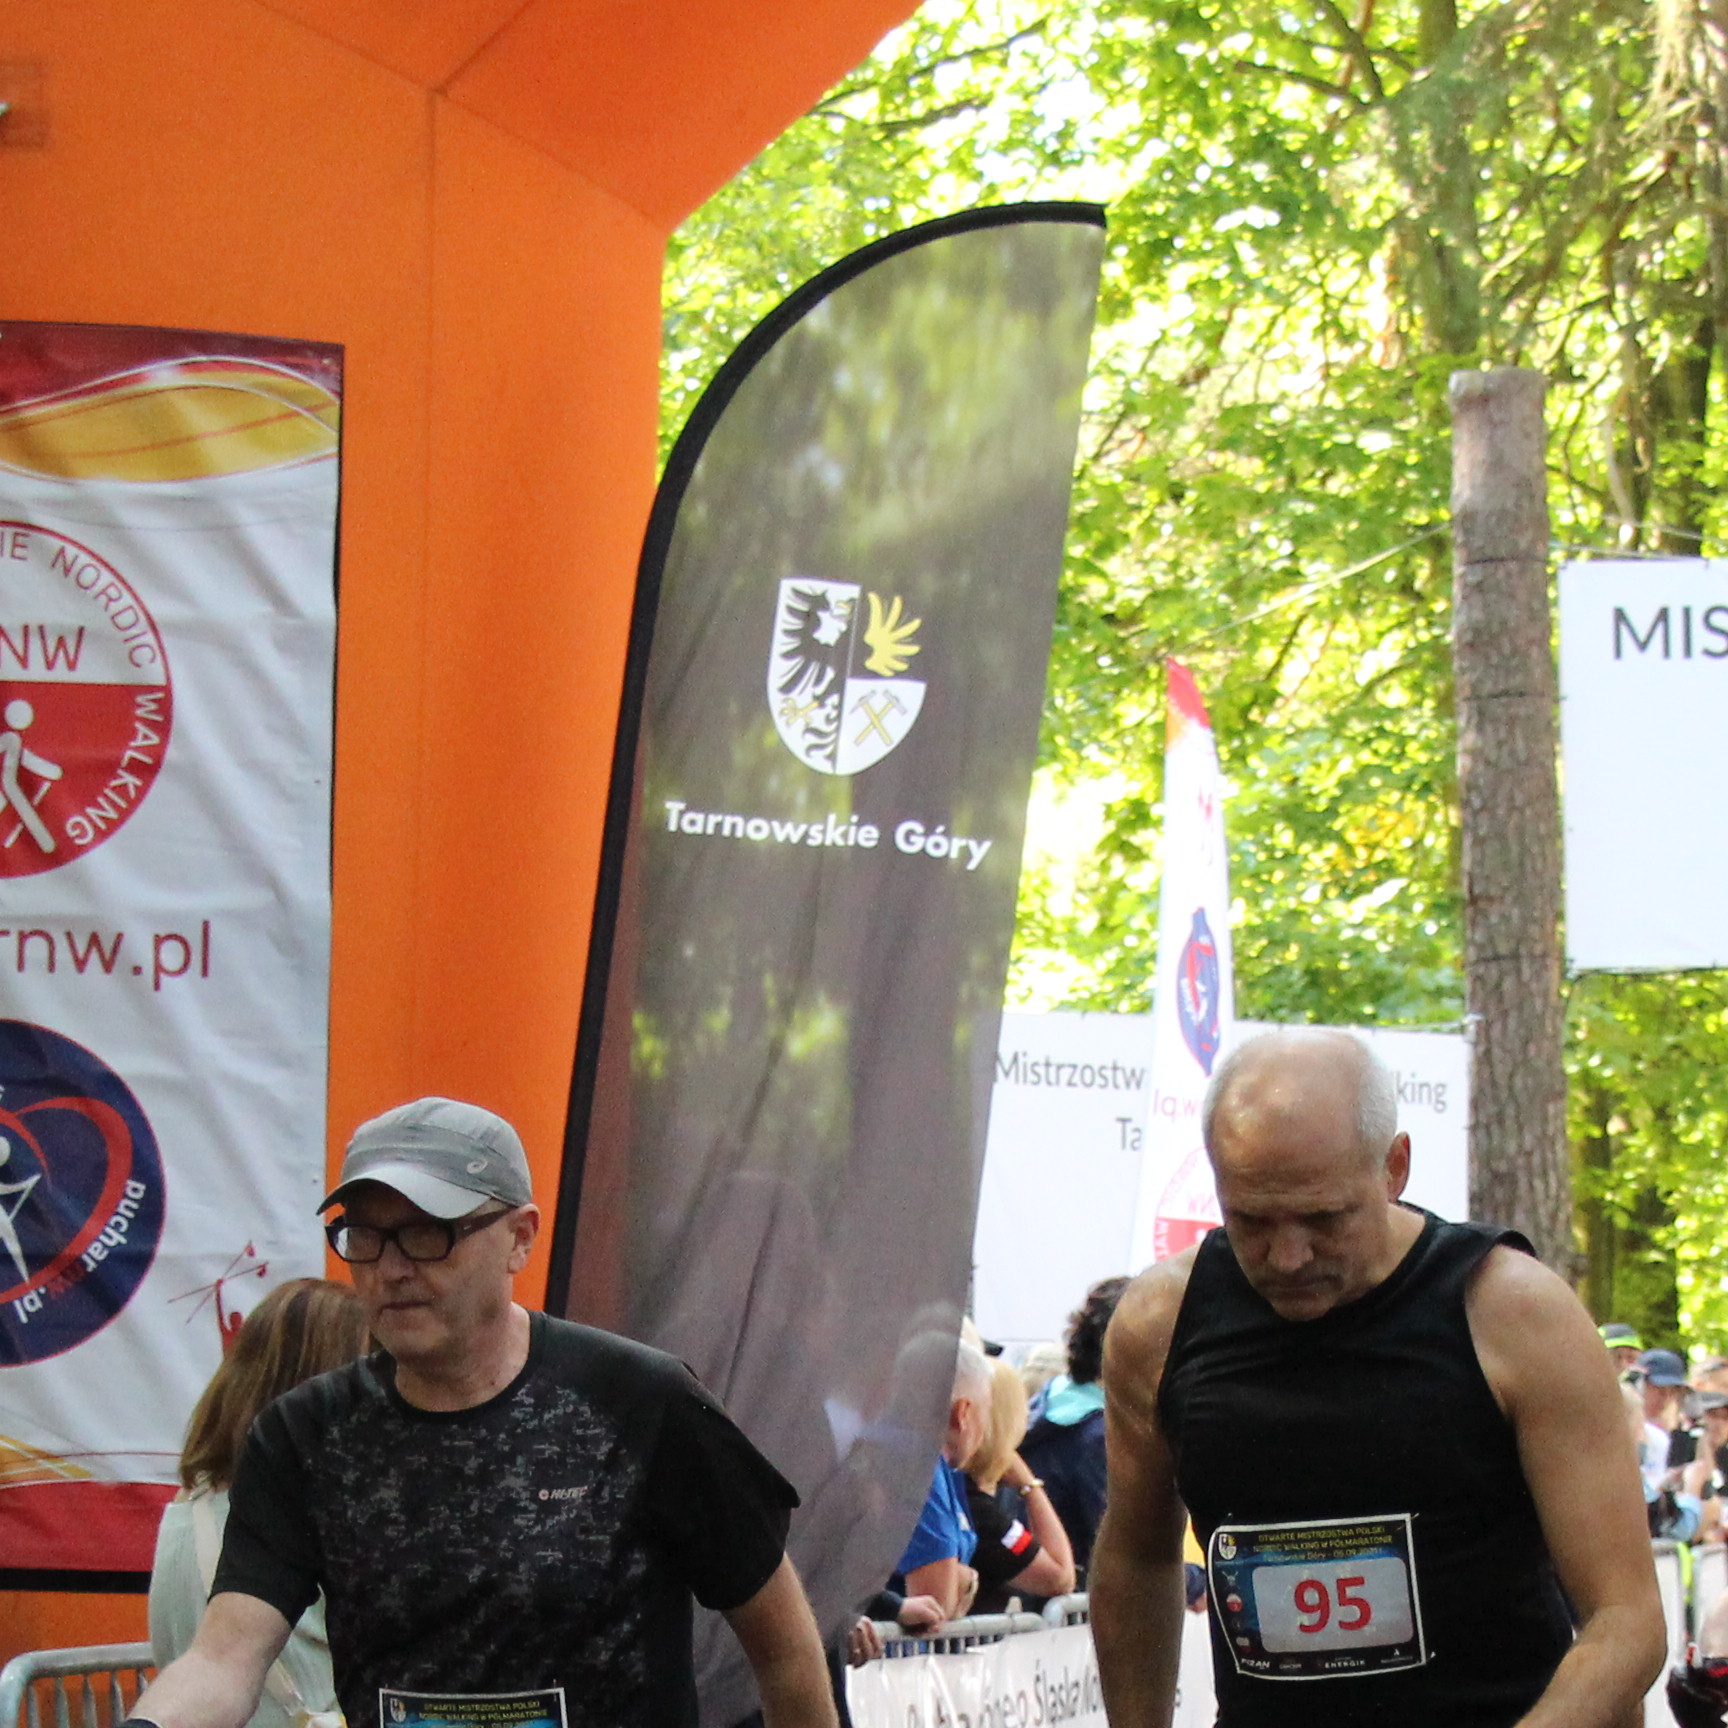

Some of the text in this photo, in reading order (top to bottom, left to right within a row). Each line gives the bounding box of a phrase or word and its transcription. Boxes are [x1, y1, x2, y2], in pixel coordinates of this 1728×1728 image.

[51, 546, 157, 669] NORDIC
[64, 690, 166, 847] WALKING
[665, 801, 991, 871] Tarnowskie Góry
[997, 1051, 1146, 1091] Mistrzostw
[1294, 1576, 1372, 1634] 95
